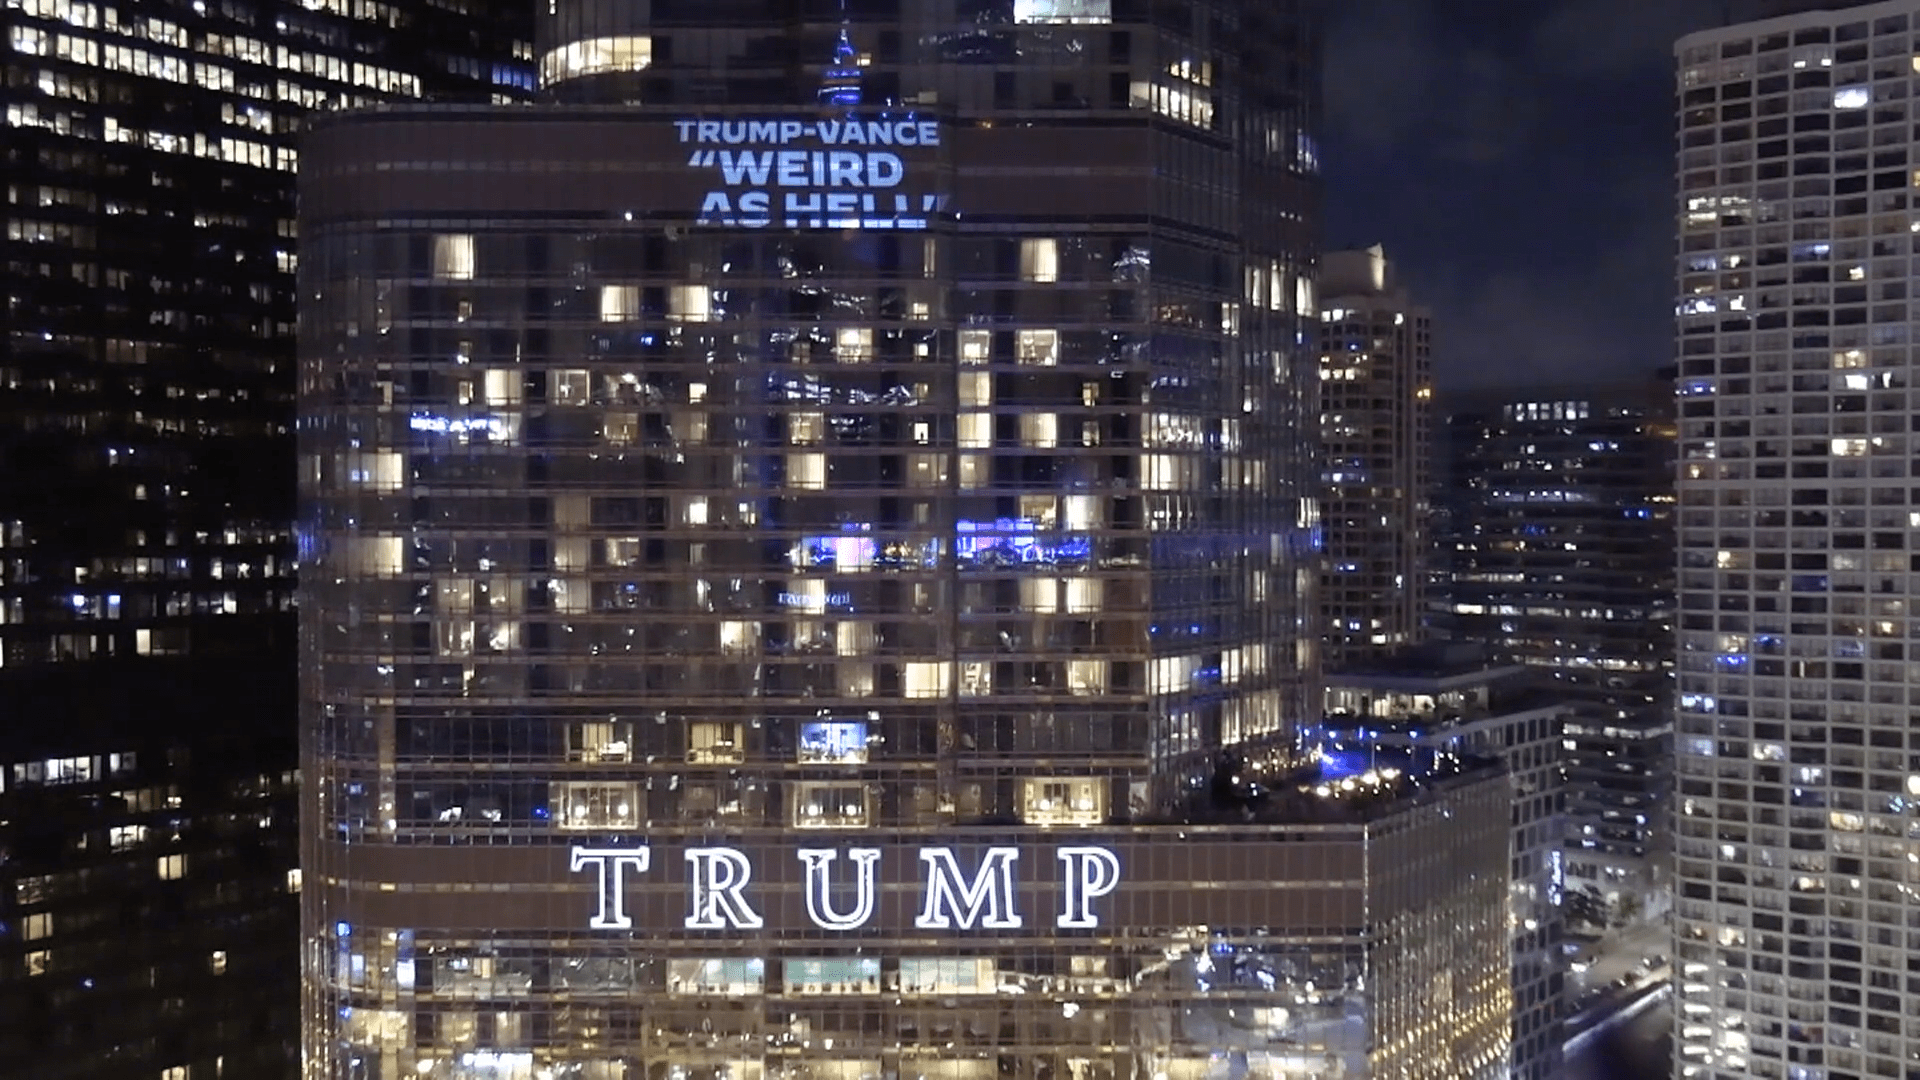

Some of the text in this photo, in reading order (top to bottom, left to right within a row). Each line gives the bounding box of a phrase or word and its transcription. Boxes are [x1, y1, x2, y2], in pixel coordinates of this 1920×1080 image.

[673, 121, 940, 145] TRUMP-VANCE
[688, 150, 904, 187] “WEIRD
[696, 192, 771, 228] AS
[570, 846, 1120, 931] TRUMP
